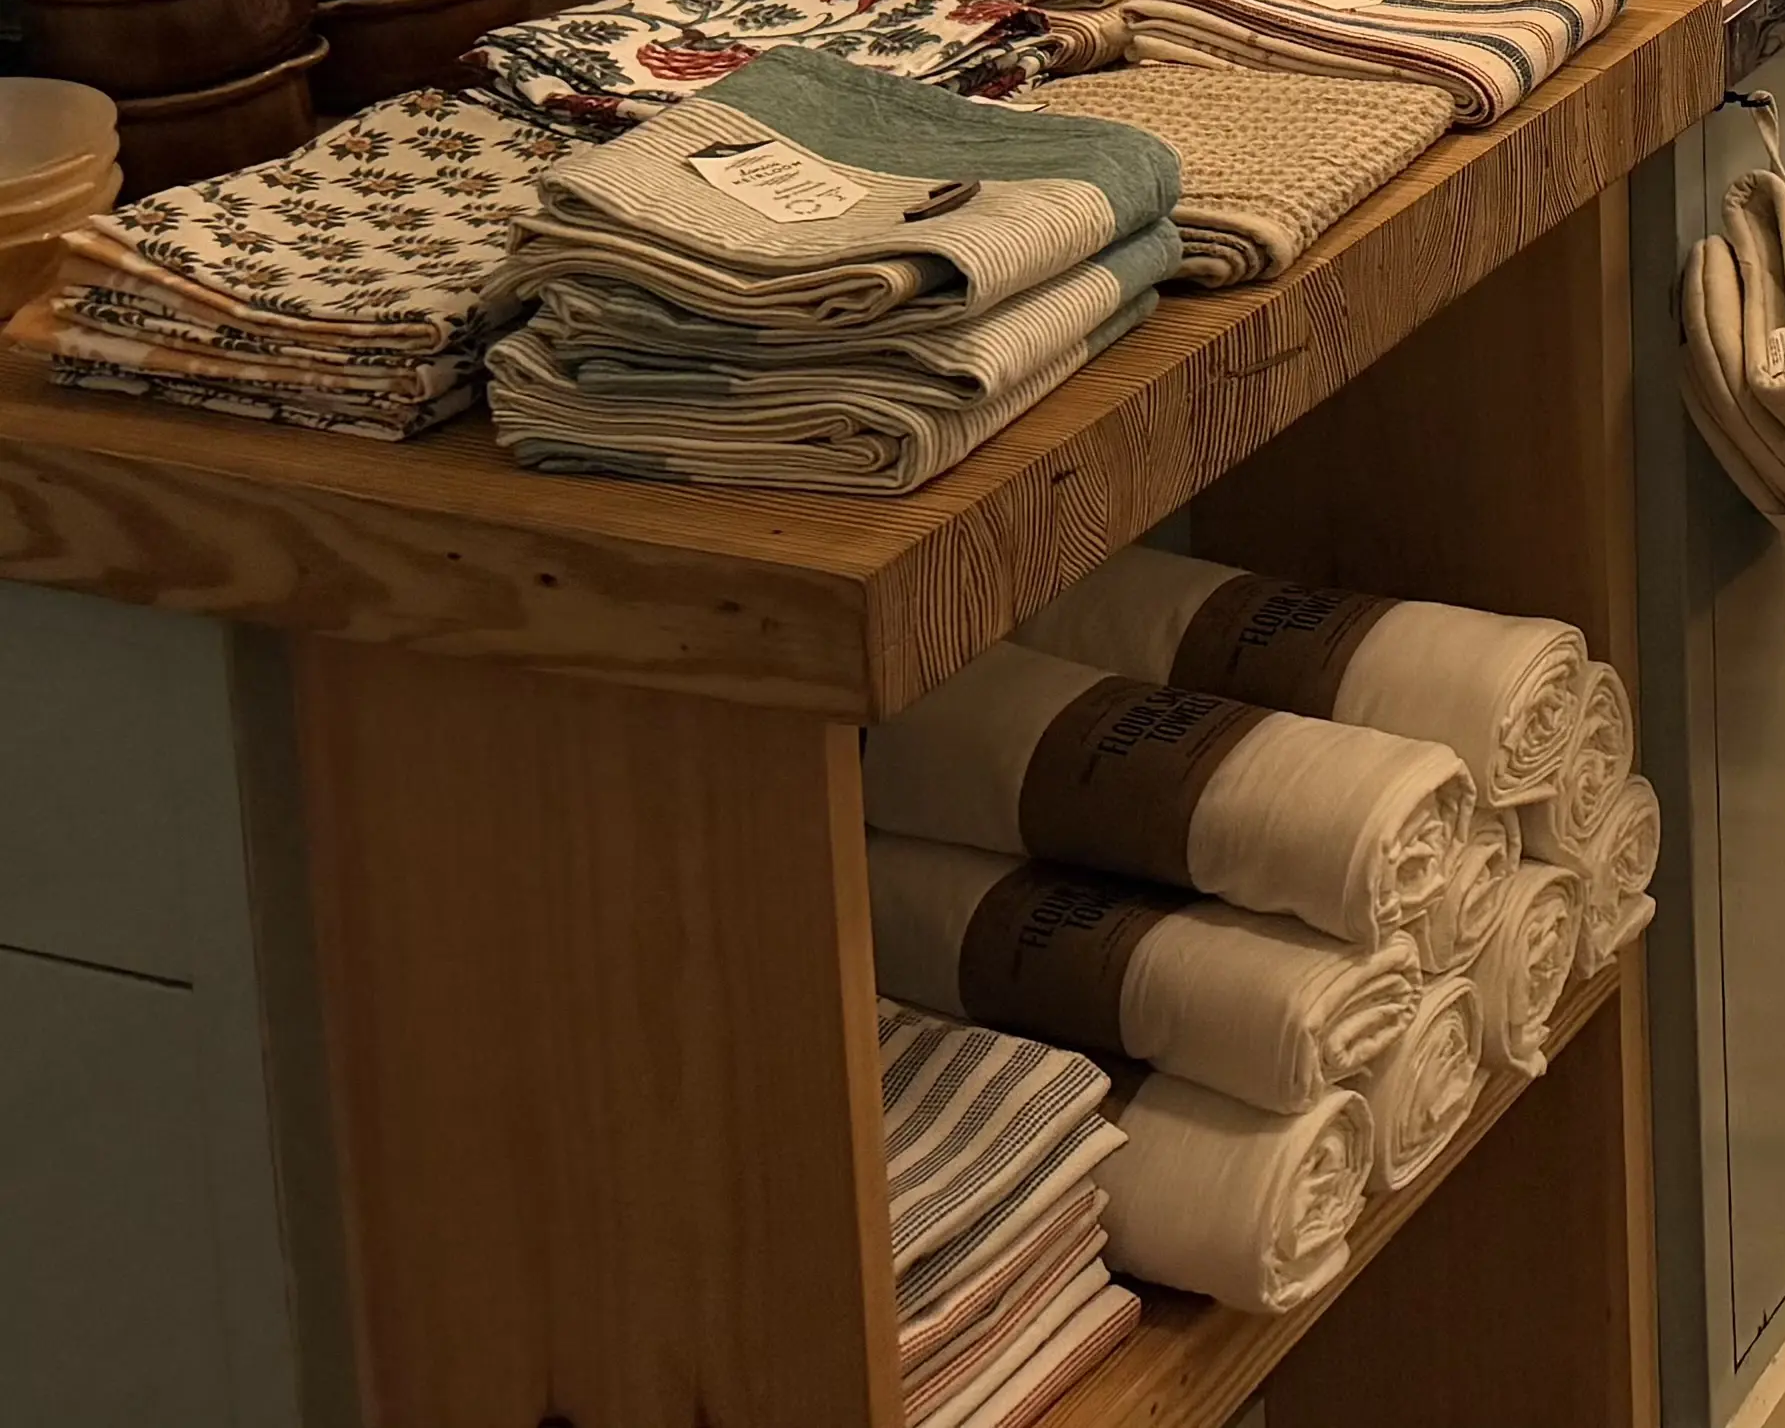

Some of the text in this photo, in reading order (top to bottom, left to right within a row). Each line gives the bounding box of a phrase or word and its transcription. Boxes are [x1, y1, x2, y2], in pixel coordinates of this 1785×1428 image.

[731, 160, 803, 185] HEIRLOOM
[1241, 594, 1298, 648] FLOUR
[1097, 704, 1154, 757] FLOUR
